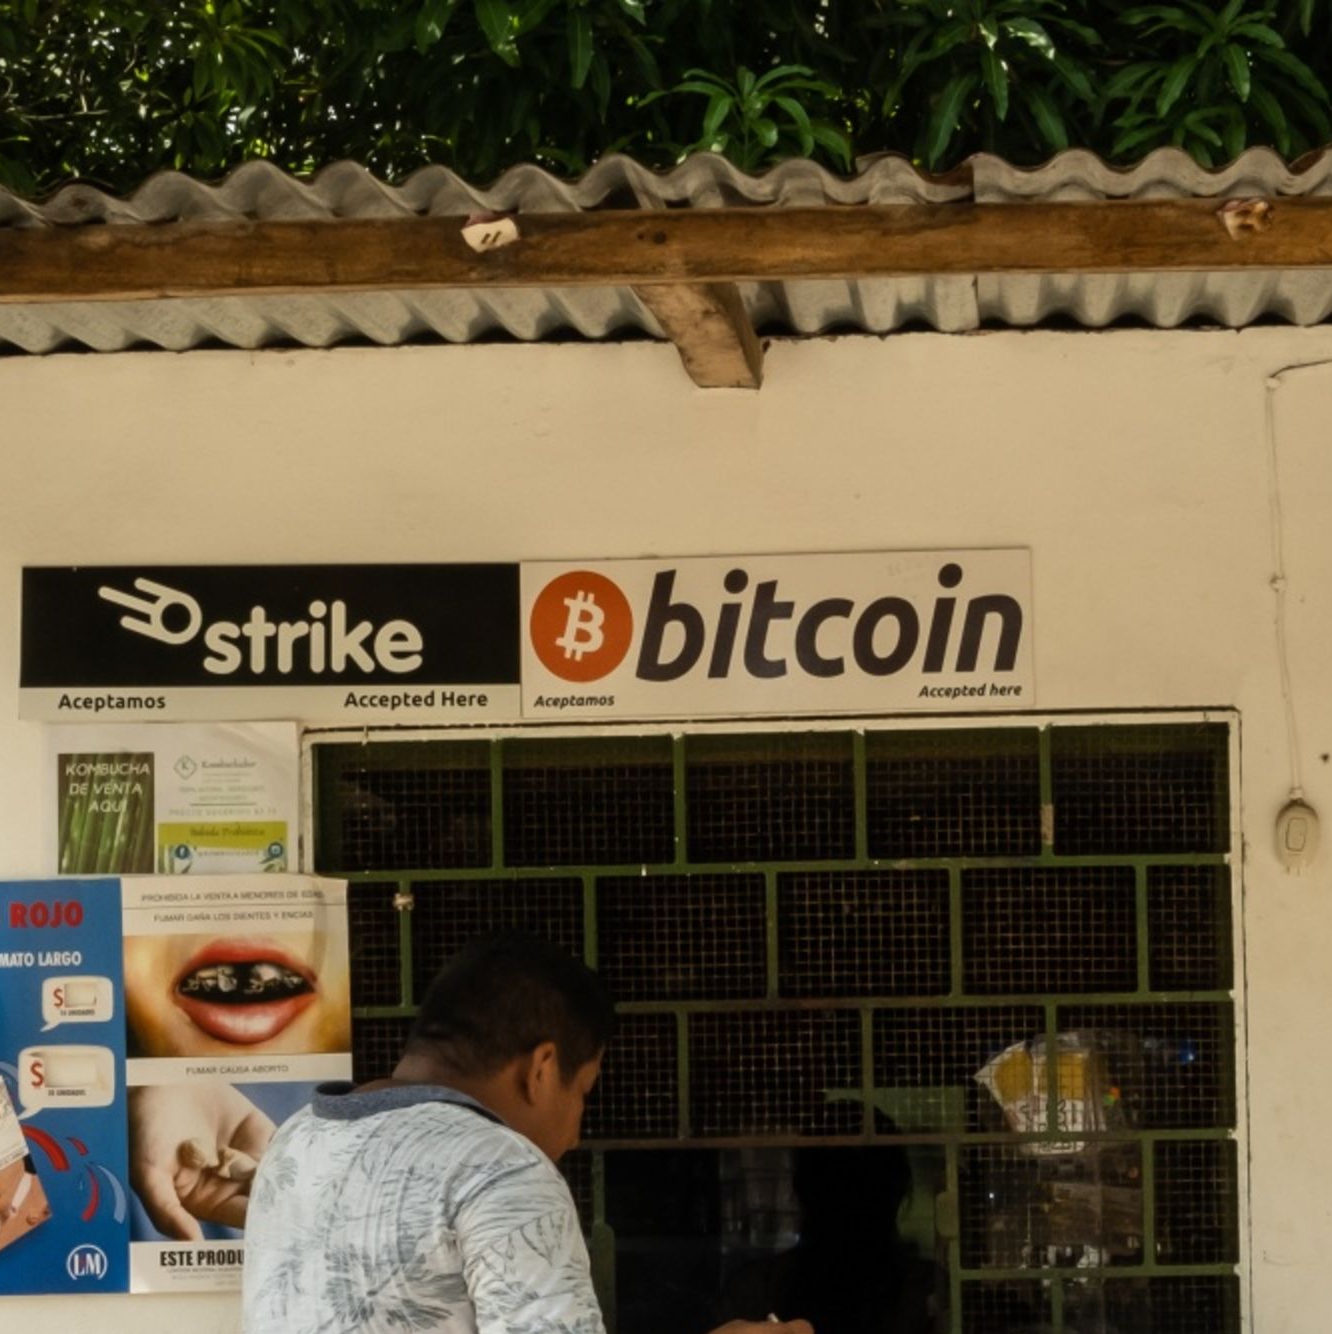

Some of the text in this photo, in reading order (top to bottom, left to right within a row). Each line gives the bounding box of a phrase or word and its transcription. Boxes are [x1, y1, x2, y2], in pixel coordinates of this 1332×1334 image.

[635, 562, 1023, 683] bitcoin
[203, 599, 423, 675] strike
[918, 683, 1023, 700] Accepted here
[58, 694, 166, 712] Aceptamos
[344, 690, 489, 710] Accepted Here
[533, 694, 615, 710] Aceptamos
[65, 762, 150, 777] KOMBUCHA
[69, 783, 143, 795] DE VENTA
[141, 893, 189, 902] PROHIBIDA
[190, 893, 201, 901] LA
[203, 892, 232, 901] VENTA
[240, 891, 284, 900] MENORES
[286, 891, 299, 899] DE
[9, 900, 84, 928] ROJO
[154, 913, 185, 922] FUMAR
[213, 912, 231, 921] LOS
[233, 911, 271, 921] DIENTES
[37, 951, 82, 967] LARGO
[185, 1064, 289, 1075] FUMAR CAUSA ABORTO
[160, 1248, 245, 1267] ESTE PRODU
